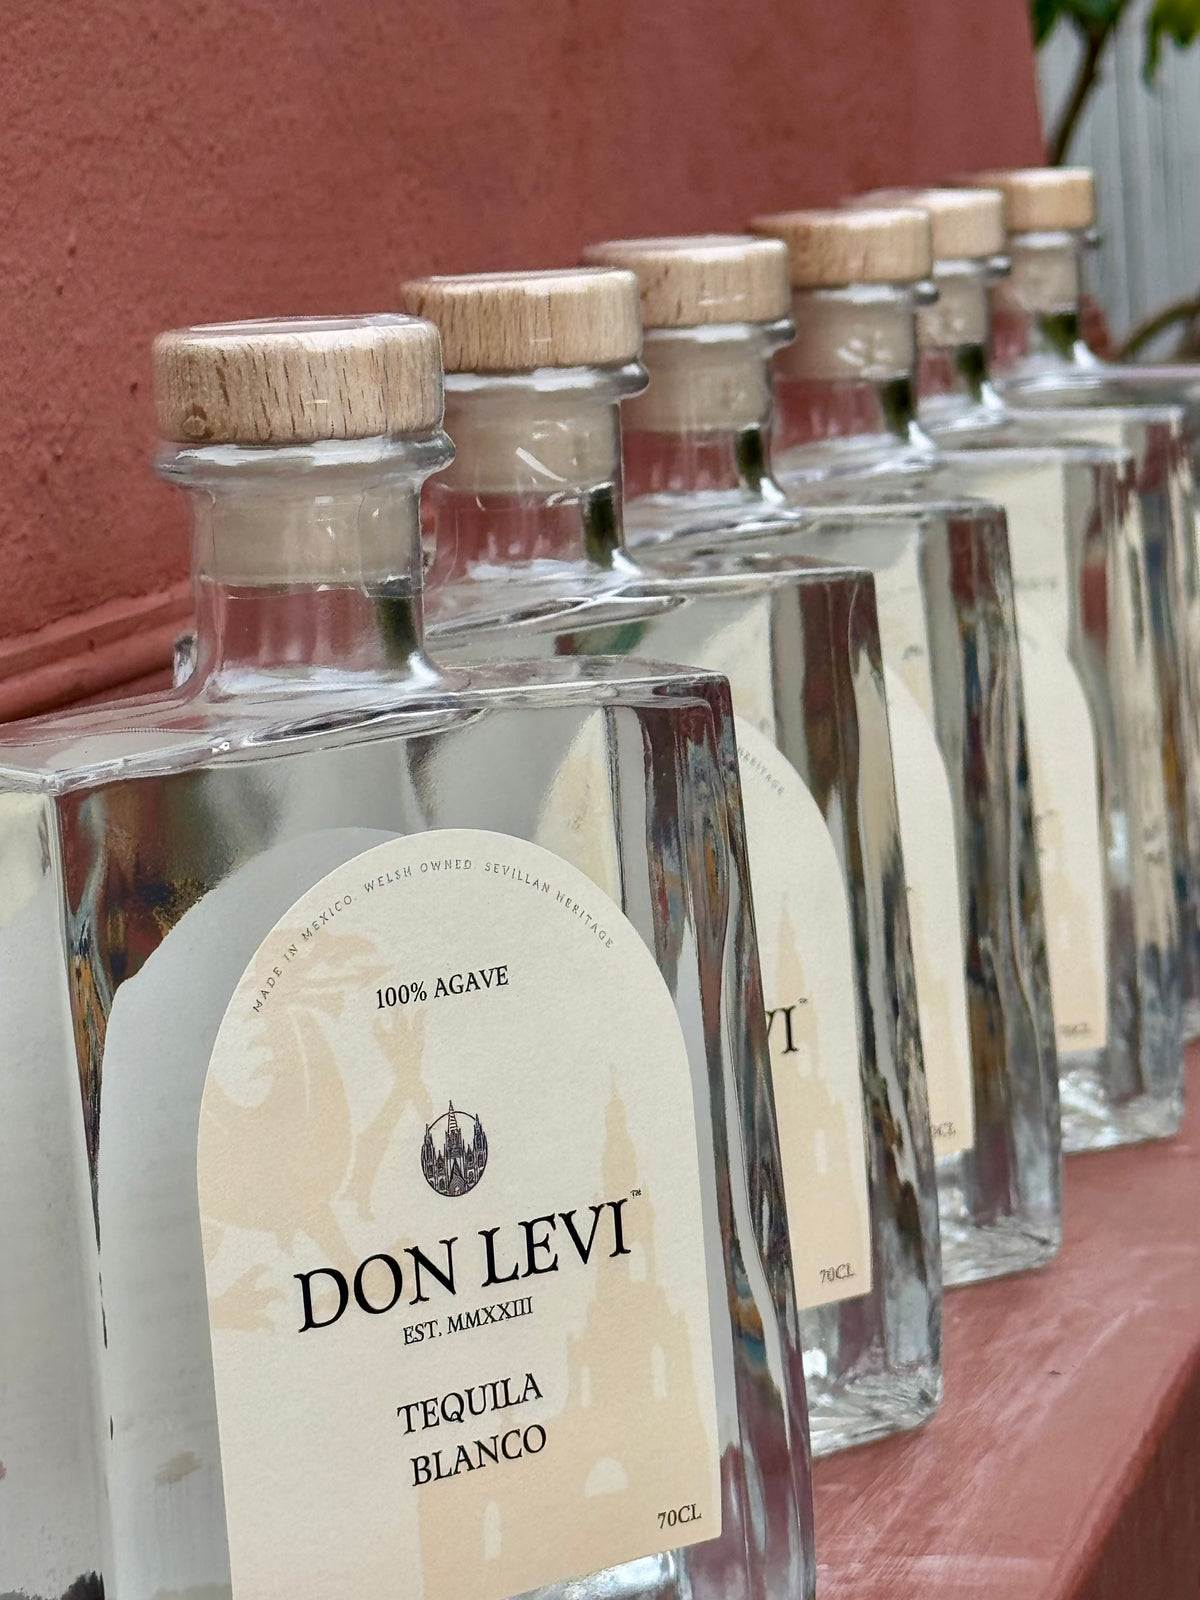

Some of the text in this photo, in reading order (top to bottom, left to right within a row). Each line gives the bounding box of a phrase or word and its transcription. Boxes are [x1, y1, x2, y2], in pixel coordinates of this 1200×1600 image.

[252, 966, 283, 1013] MADE
[282, 943, 299, 963] IN
[363, 865, 413, 893] WELSH
[484, 861, 551, 894] SEVILLAN
[556, 890, 614, 949] HERITAGE
[376, 964, 510, 1010] 100% AGAVE
[293, 1236, 459, 1334] DON
[403, 1295, 534, 1347] EST. MMXXIII
[396, 1372, 544, 1436] TEQUILA
[410, 1423, 547, 1487] BLANCO
[656, 1502, 703, 1530] 70CL
